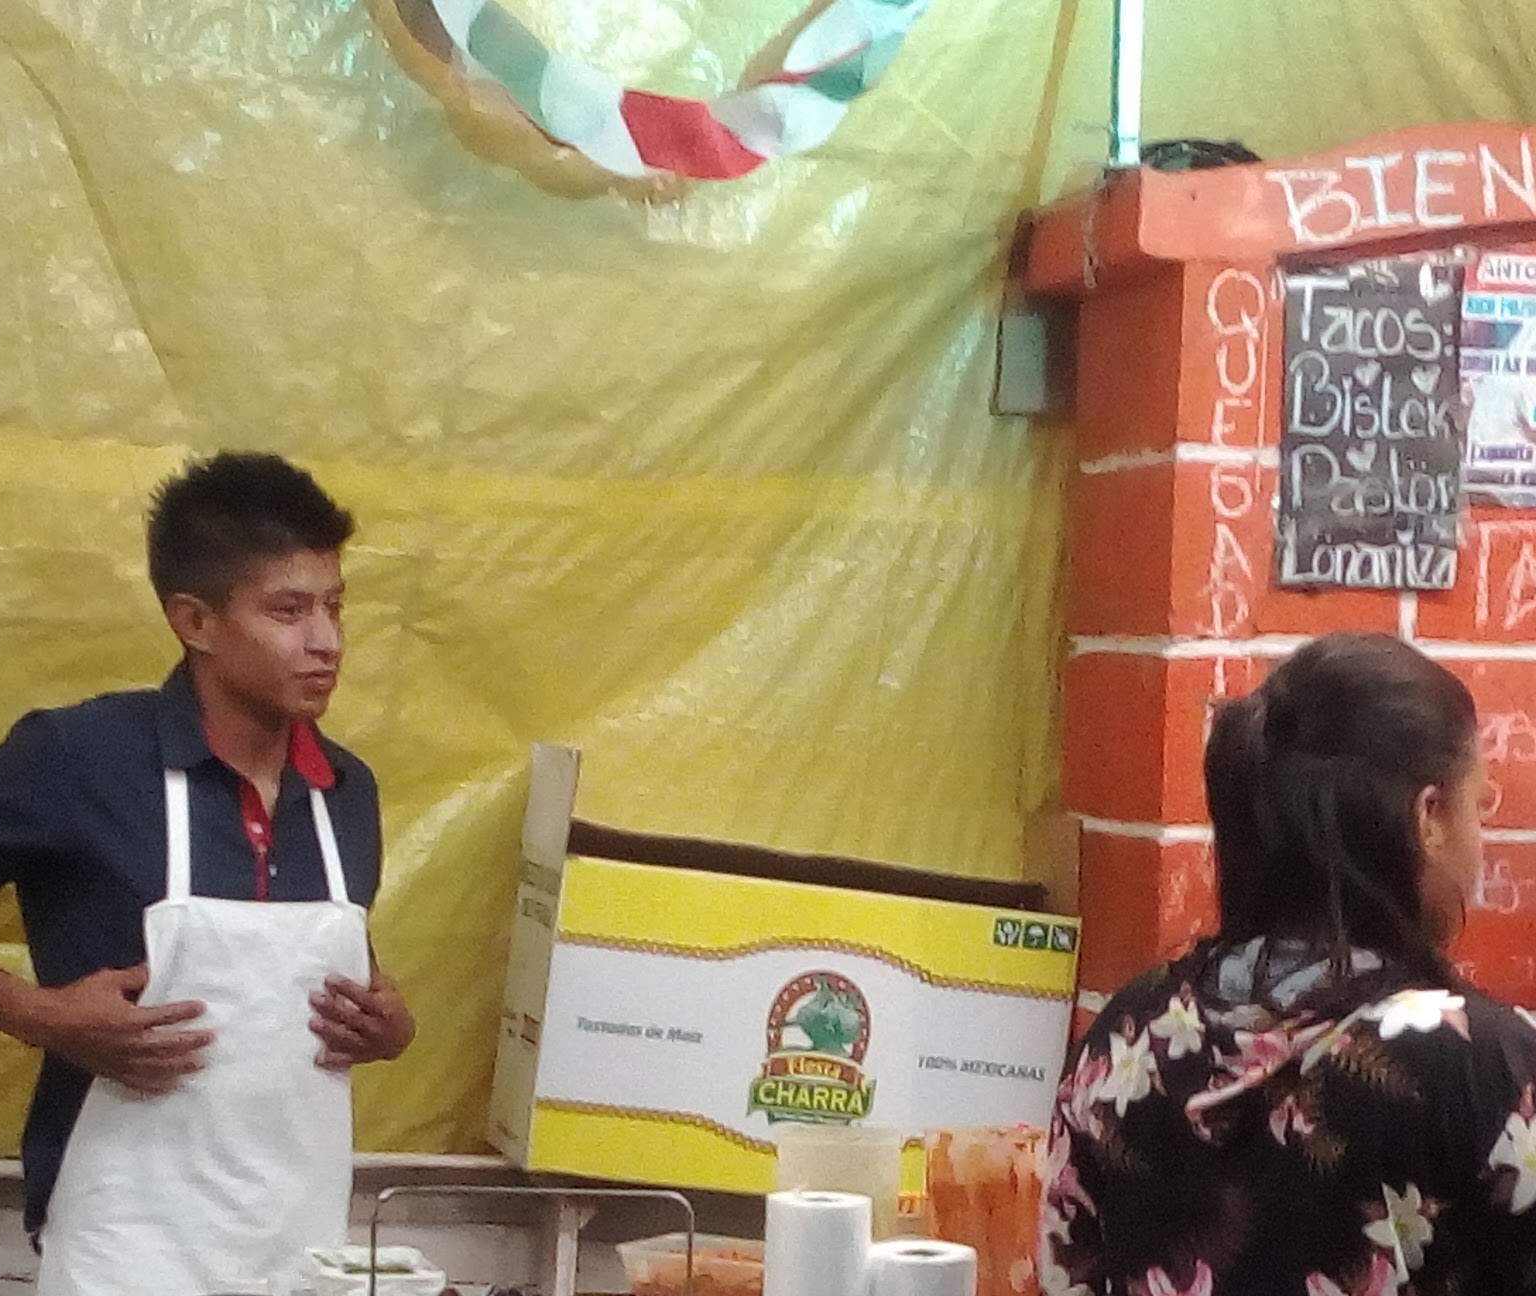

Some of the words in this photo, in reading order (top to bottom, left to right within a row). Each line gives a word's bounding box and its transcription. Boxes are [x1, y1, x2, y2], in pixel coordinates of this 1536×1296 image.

[1286, 275, 1454, 361] Tacos:
[960, 1058, 1046, 1082] MEXICANAS
[758, 1081, 864, 1115] CHARRA
